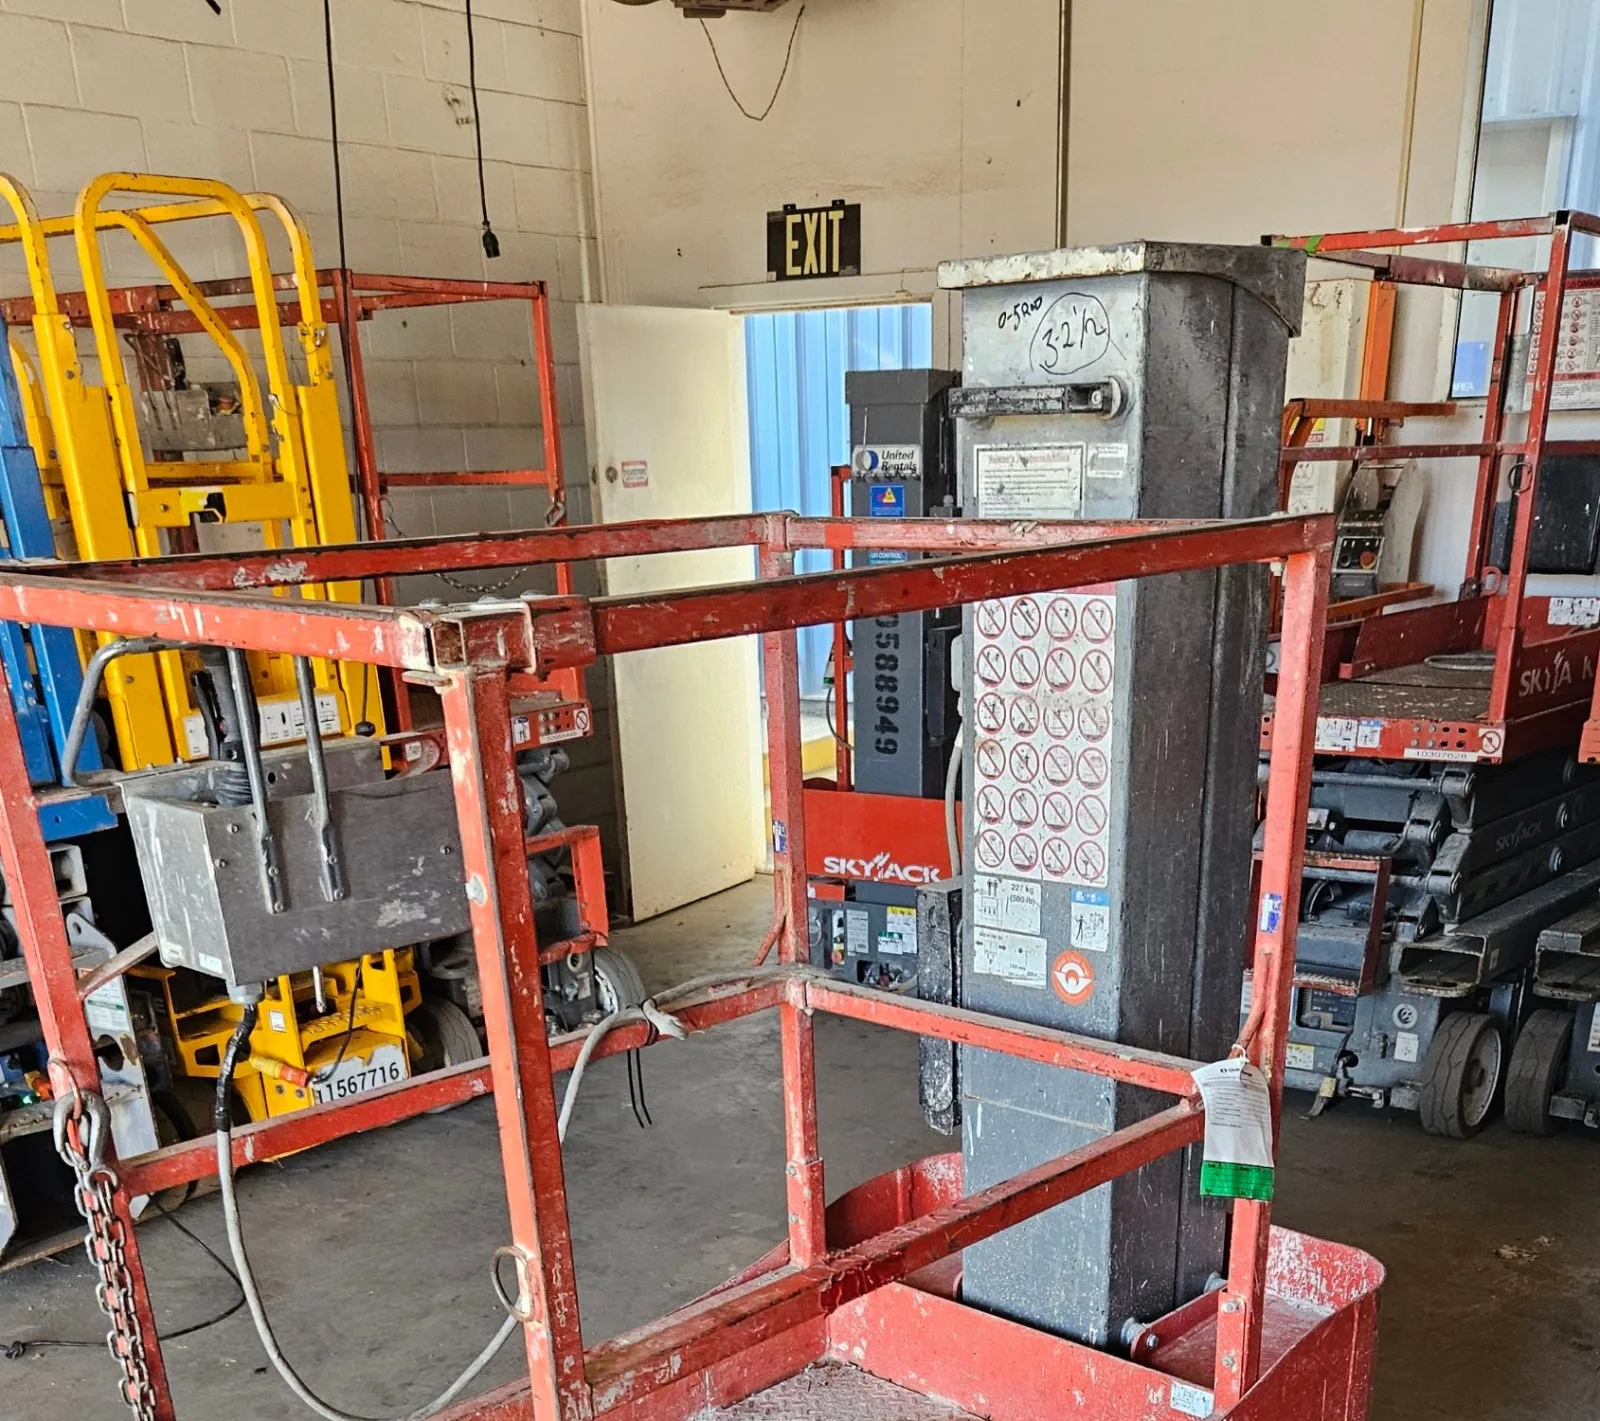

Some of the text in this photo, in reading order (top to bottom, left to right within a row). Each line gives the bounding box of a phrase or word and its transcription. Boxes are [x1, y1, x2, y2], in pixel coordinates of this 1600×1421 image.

[786, 210, 845, 276] EXIT
[881, 450, 915, 460] United
[881, 462, 917, 472] Rentals
[1416, 750, 1467, 760] 10397628
[824, 852, 941, 883] SKYJACK
[317, 1062, 399, 1104] 11567716
